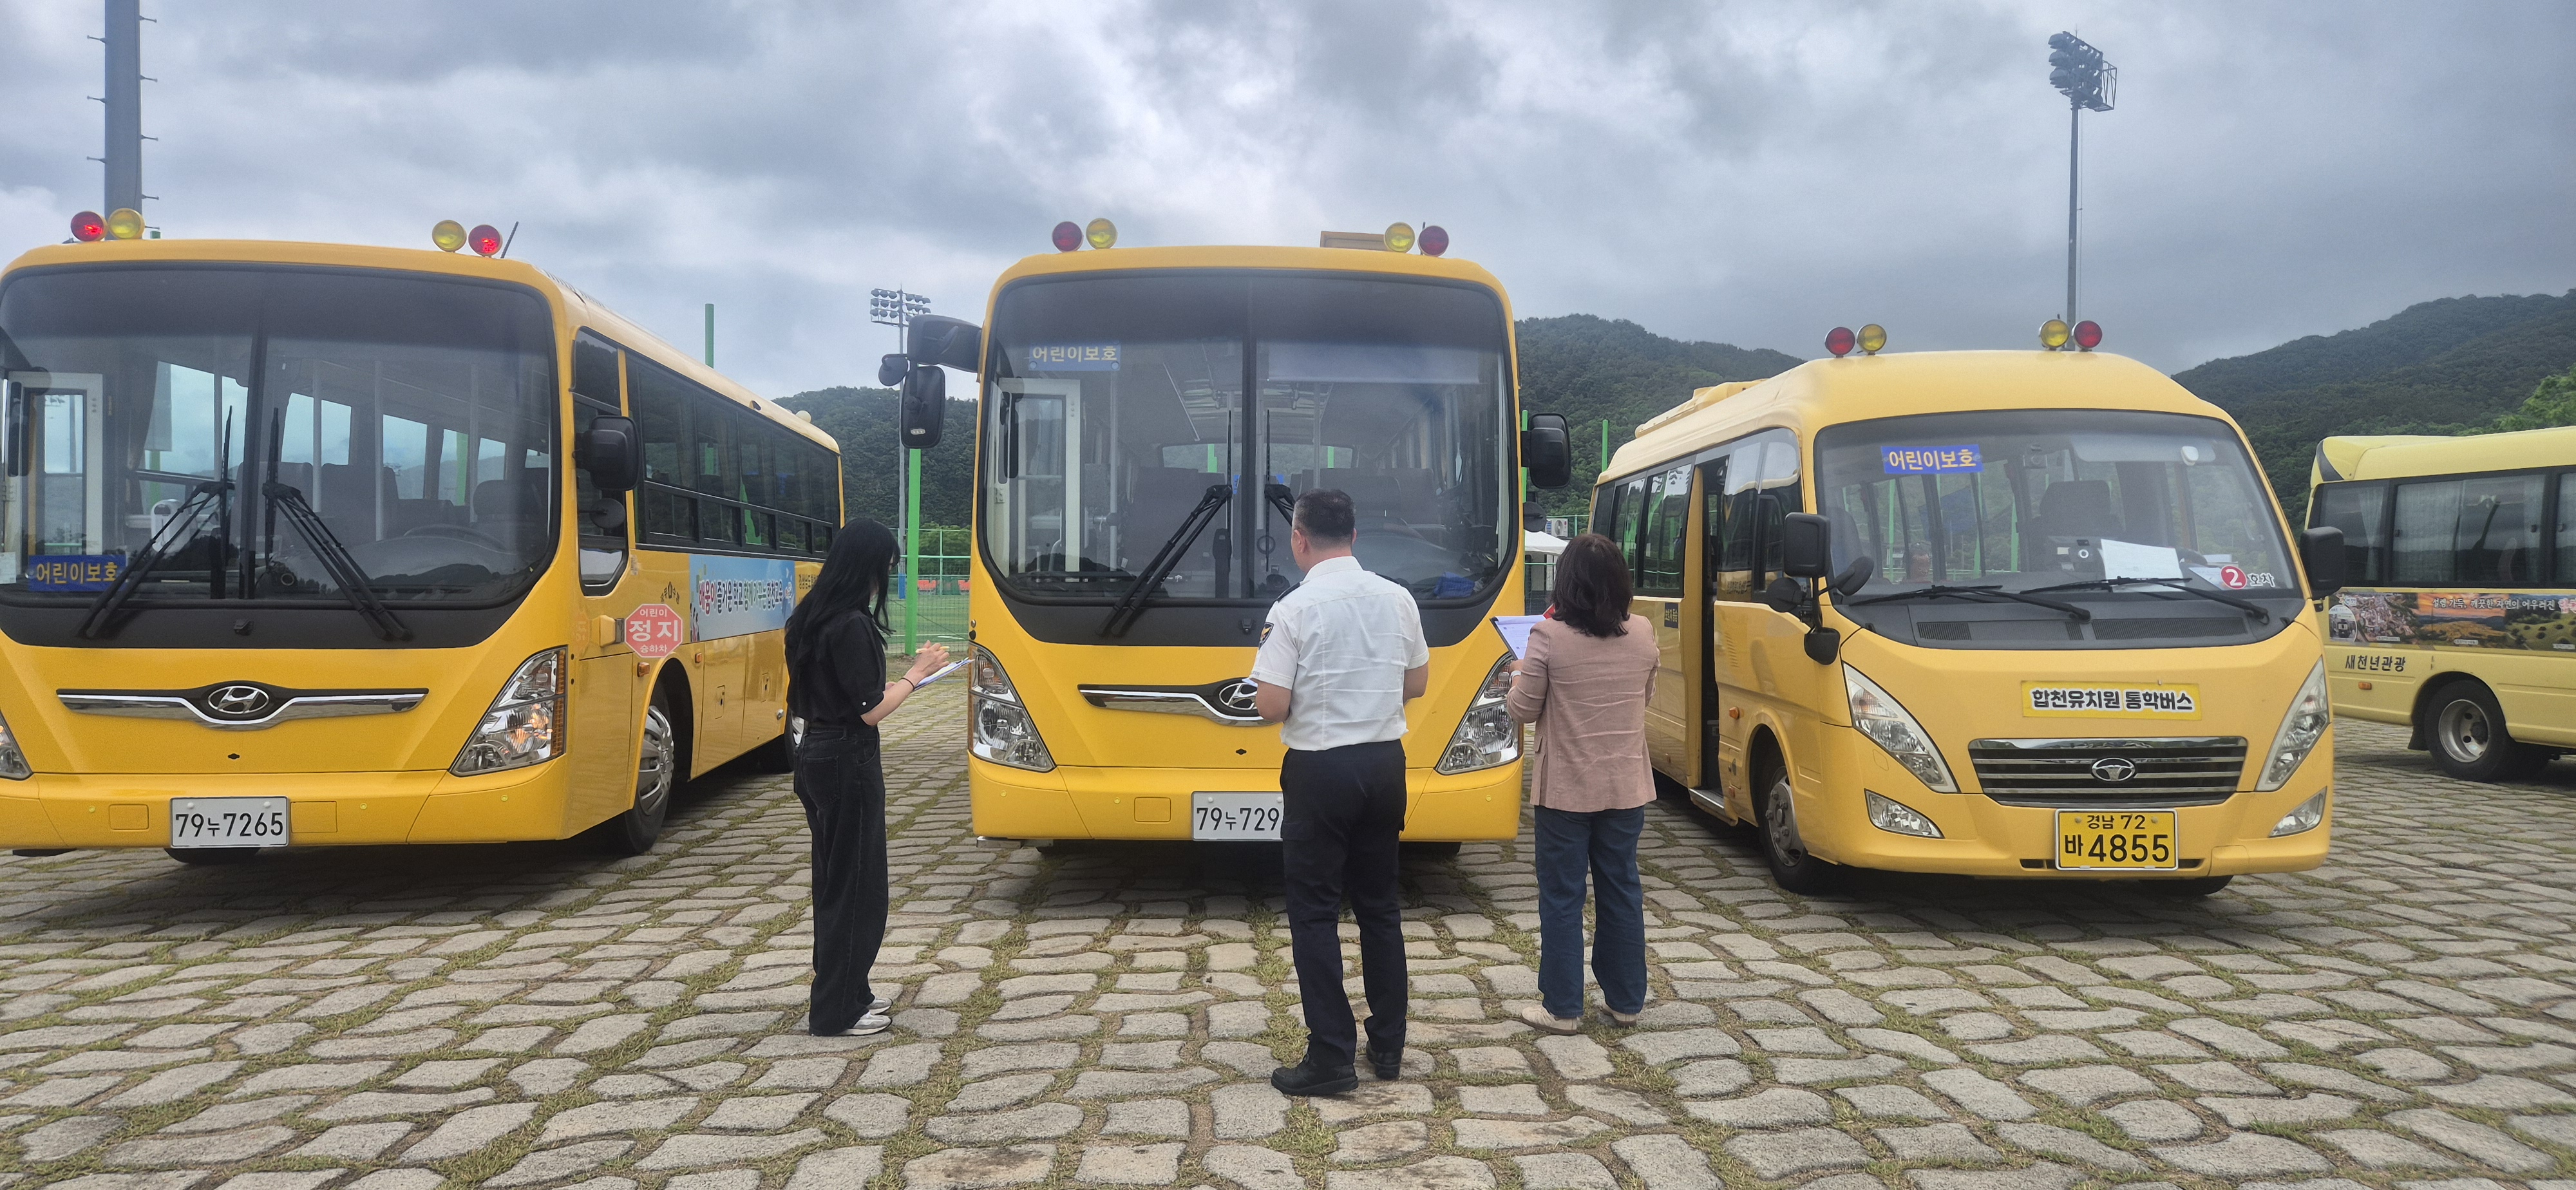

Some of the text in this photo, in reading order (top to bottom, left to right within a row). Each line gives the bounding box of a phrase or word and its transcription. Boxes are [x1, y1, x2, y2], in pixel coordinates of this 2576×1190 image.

[1032, 346, 1117, 363] 어린이보호
[1889, 449, 1976, 470] 어린이보호
[37, 562, 118, 584] 어린이보호
[2225, 569, 2242, 586] 2
[699, 581, 716, 614] 배움이
[717, 581, 732, 614] 즐거운
[2448, 598, 2467, 609] 가득,
[2470, 598, 2494, 609] 깨끗한
[2522, 599, 2555, 610] 어우러진
[640, 609, 667, 617] 어린이
[2345, 654, 2406, 672] 새천년관광
[2031, 689, 2193, 710] 합천유치원 통학버스
[175, 812, 283, 837] 79누7265
[1197, 807, 1280, 831] 79누729
[2087, 815, 2146, 829] 경남 72
[2065, 834, 2169, 862] 바 4855
